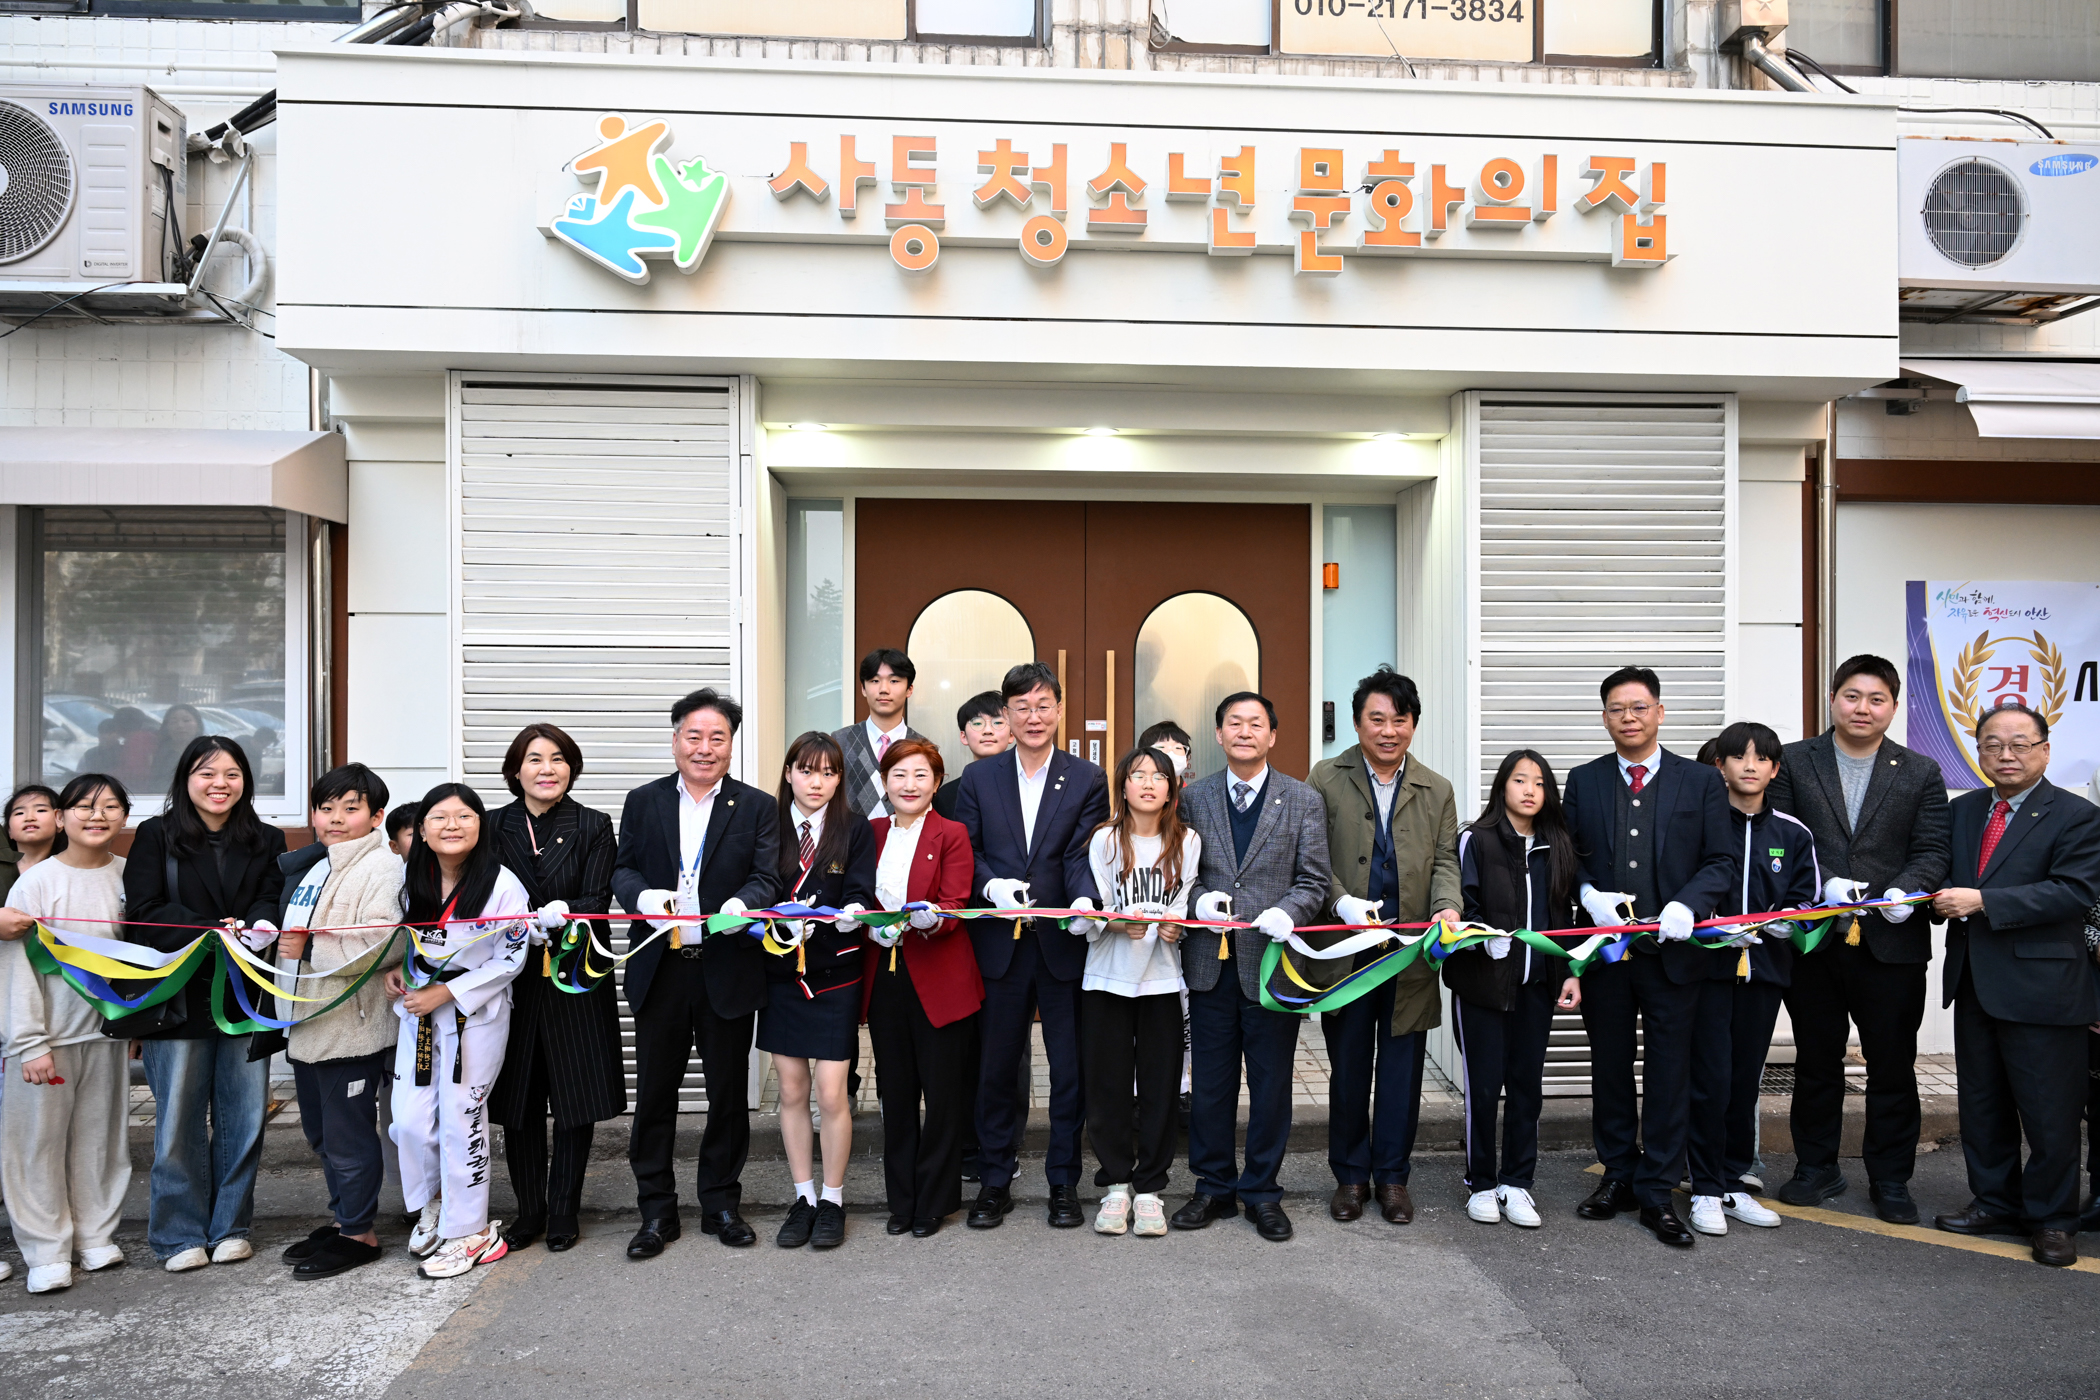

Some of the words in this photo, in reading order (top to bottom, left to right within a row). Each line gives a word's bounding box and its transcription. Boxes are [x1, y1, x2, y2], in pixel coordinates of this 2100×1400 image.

[1294, 0, 1524, 22] 010-2171-3834
[49, 102, 133, 116] SAMSUNG
[2037, 160, 2091, 170] SAMSUNG
[1936, 588, 1969, 608] 시민과
[1947, 607, 1979, 624] 자유로운
[1983, 607, 2021, 623] 혁신도시
[2025, 607, 2051, 620] 안산
